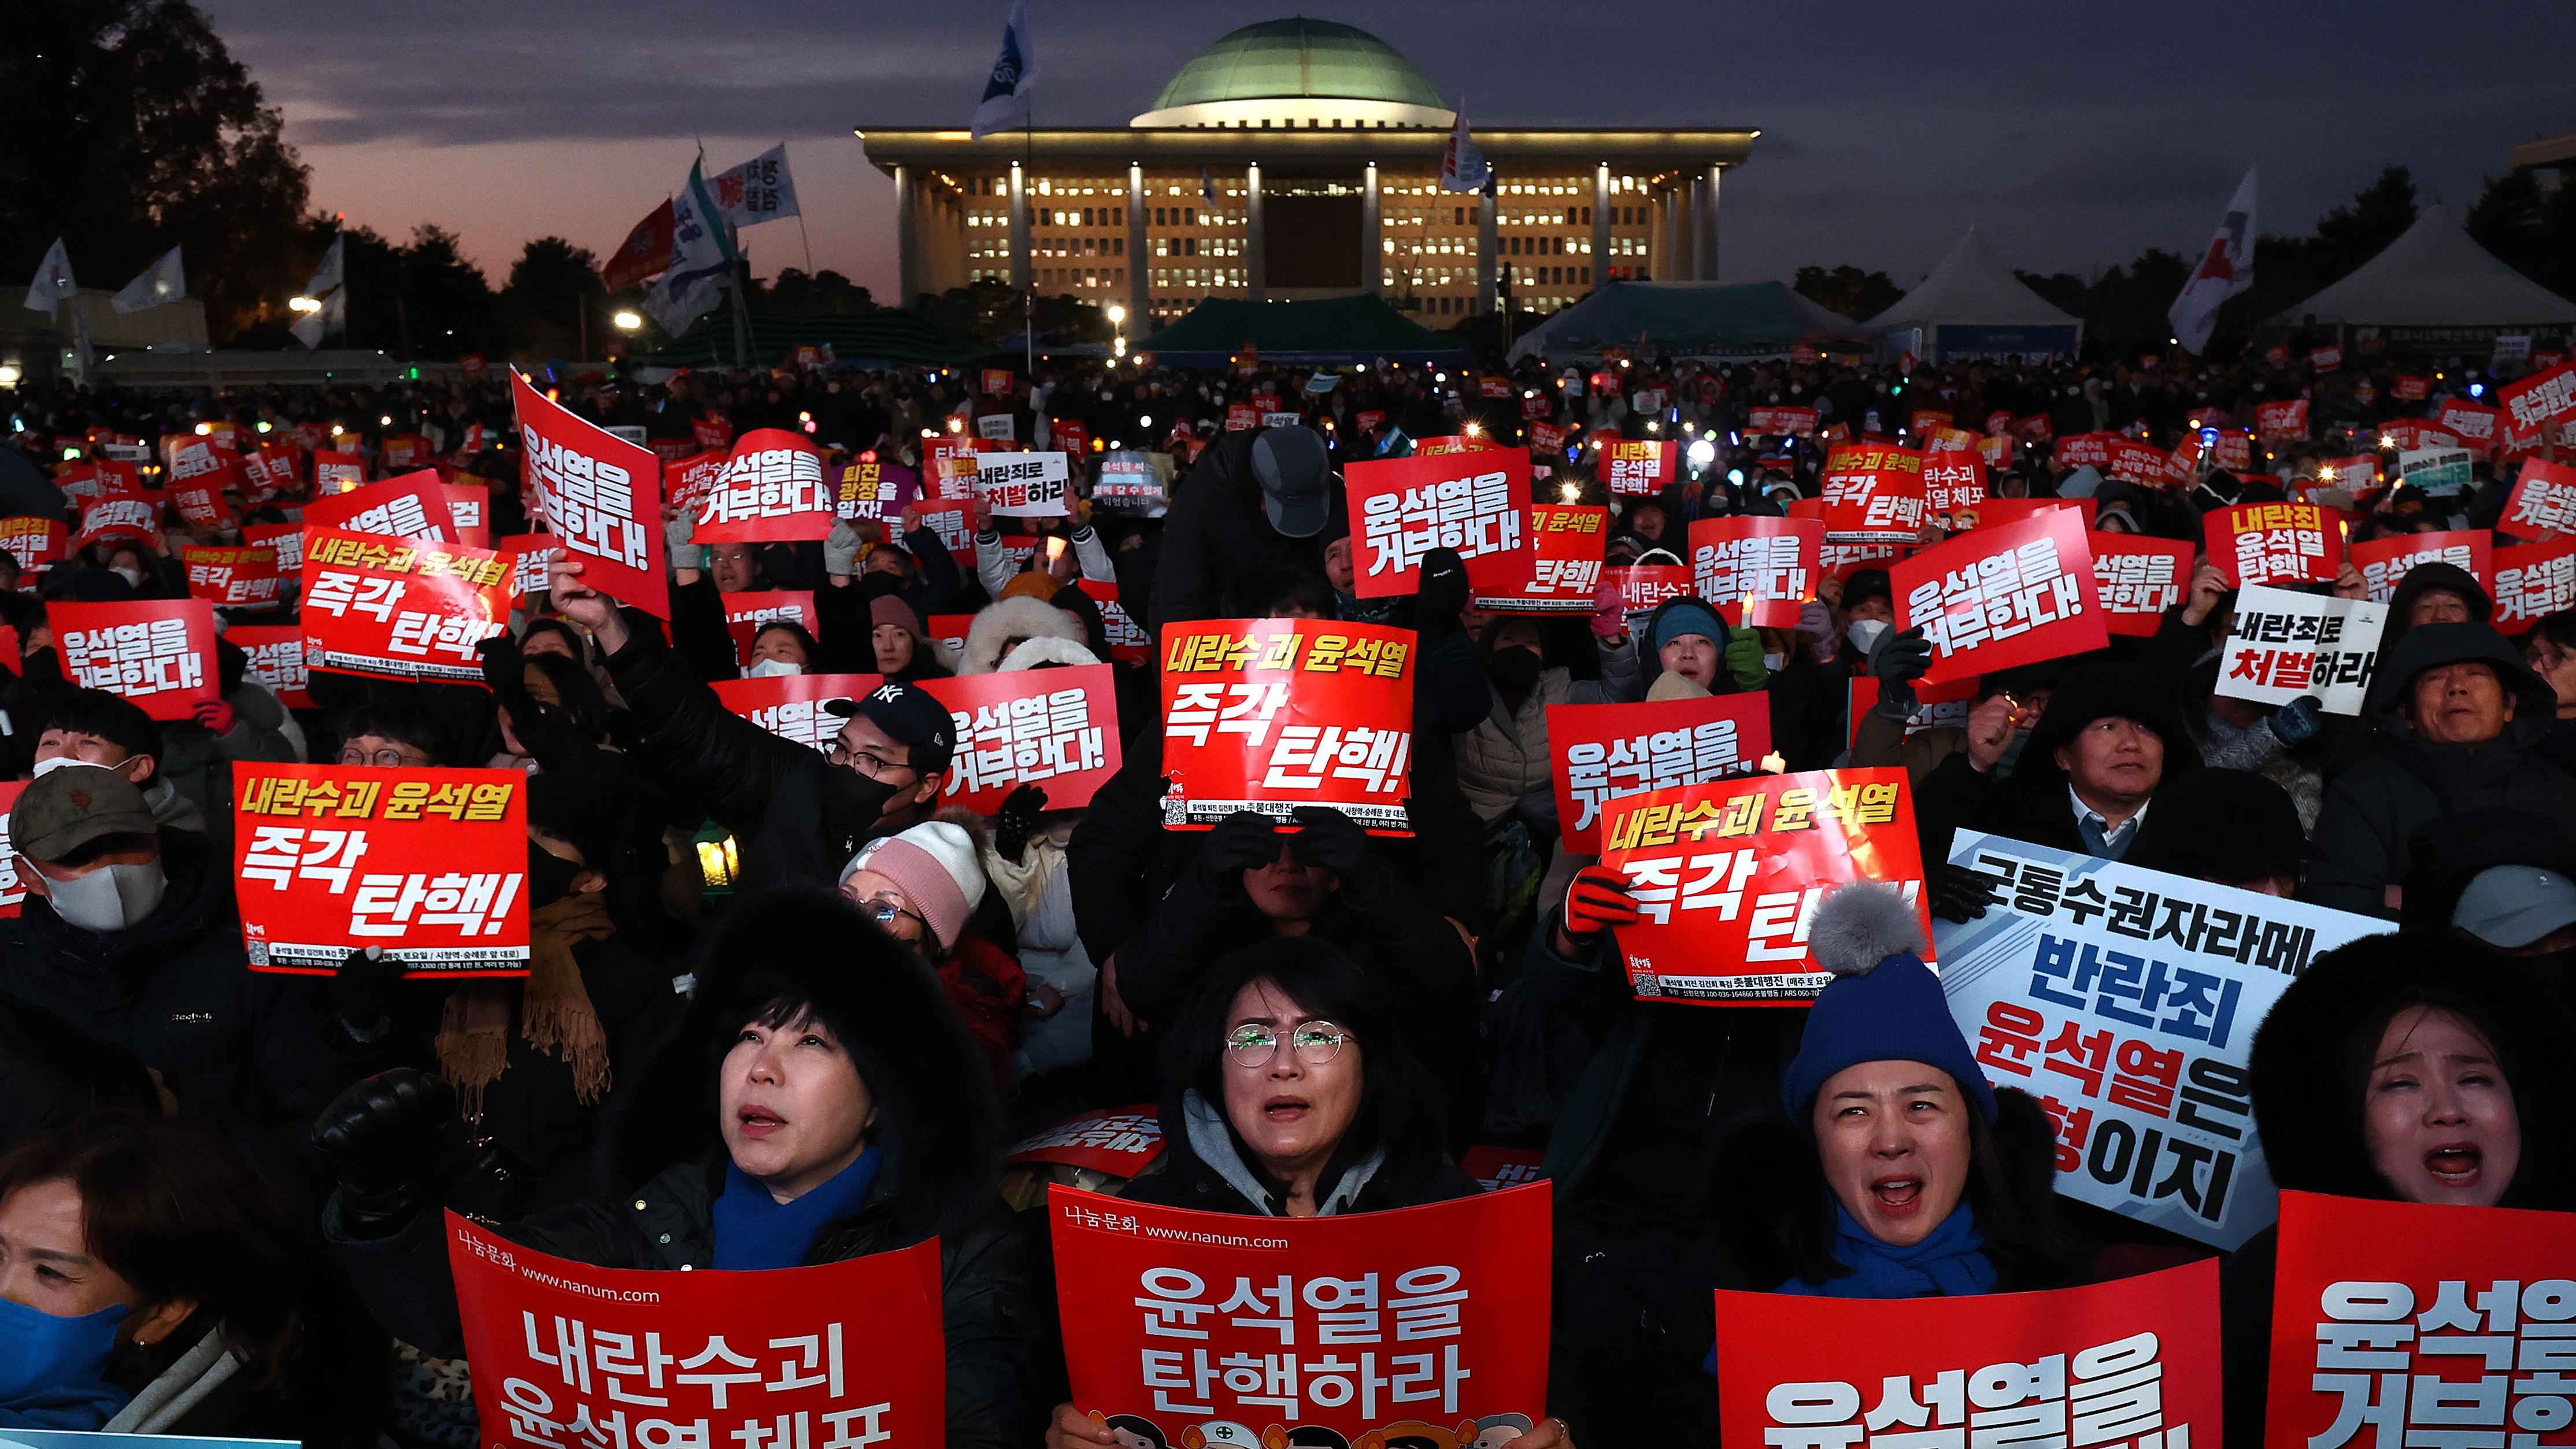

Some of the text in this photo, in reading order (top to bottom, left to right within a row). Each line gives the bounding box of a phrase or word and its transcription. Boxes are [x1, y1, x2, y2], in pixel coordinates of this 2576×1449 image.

[524, 423, 632, 519] 윤석열을
[712, 448, 821, 493] 윤석열을
[841, 464, 880, 482] 퇴진
[978, 461, 1044, 485] 내란죄로
[1611, 442, 1663, 460] 내란죄
[1611, 459, 1661, 478] 윤석열
[698, 479, 832, 526] 거부한다!
[839, 482, 898, 501] 광장을
[986, 479, 1069, 507] 처벌하라
[1363, 471, 1510, 538] 윤석열을
[1610, 477, 1649, 494] 탄핵!
[1822, 475, 1877, 507] 즉각
[1952, 487, 1985, 506] 체포
[837, 500, 882, 519] 열자!
[1547, 513, 1602, 534] 윤석열
[1864, 496, 1925, 528] 탄핵!
[2231, 504, 2322, 534] 내란죄
[309, 537, 419, 574] 내란수괴
[417, 551, 509, 586] 윤석열
[1366, 509, 1522, 577] 거부한다!
[1694, 535, 1800, 580] 윤석열을
[2234, 528, 2325, 560] 윤석열
[190, 565, 233, 589] 즉각
[226, 578, 277, 601] 탄핵!
[1524, 559, 1602, 593] 탄핵!
[1693, 568, 1806, 605] 거부한다!
[1908, 537, 2062, 627] 윤석열을
[2238, 553, 2310, 585] 탄핵!
[306, 571, 406, 623] 즉각
[1918, 572, 2084, 658] 거부한다!
[63, 617, 189, 667] 윤석열을
[388, 611, 505, 661] 탄핵!
[2229, 612, 2345, 646] 내란죄로
[71, 651, 205, 697] 거부한다!
[1166, 634, 1409, 678] 내란수괴 윤석열
[2229, 648, 2374, 690] 처벌하라
[951, 686, 1089, 755] 윤석열을
[1165, 683, 1289, 747] 즉각
[945, 726, 1105, 796] 거부한다!
[1262, 725, 1411, 793] 탄핵!
[1568, 719, 1739, 789] 윤석열을
[240, 778, 514, 822] 내란수괴 윤석열
[1345, 807, 1383, 817] 시청역-숭례문
[1608, 792, 1767, 852] 내란수괴
[1771, 782, 1899, 832] 윤석열
[240, 826, 369, 894] 즉각
[349, 872, 523, 937] 탄핵!
[1622, 849, 1760, 925] 즉각
[1978, 853, 2330, 977] 군통수권자라메
[1664, 978, 1683, 988] 윤석열
[1684, 978, 1698, 988] 퇴진
[1719, 979, 1733, 988] 특검
[1734, 975, 1784, 988] 촛불대행진
[1787, 977, 1805, 987] (매주
[2029, 933, 2243, 1049] 반란죄
[1975, 1000, 2252, 1140] 윤석열은
[1993, 1084, 2236, 1222] 형이지
[1064, 1205, 1289, 1250] 나눔문화 www.nanum.com
[458, 1228, 660, 1304] 나눔문화 www.nanum.com
[1134, 1265, 1468, 1346] 윤석열을
[523, 1310, 846, 1410] 내란수괴
[1141, 1344, 1470, 1421] 탄핵하라
